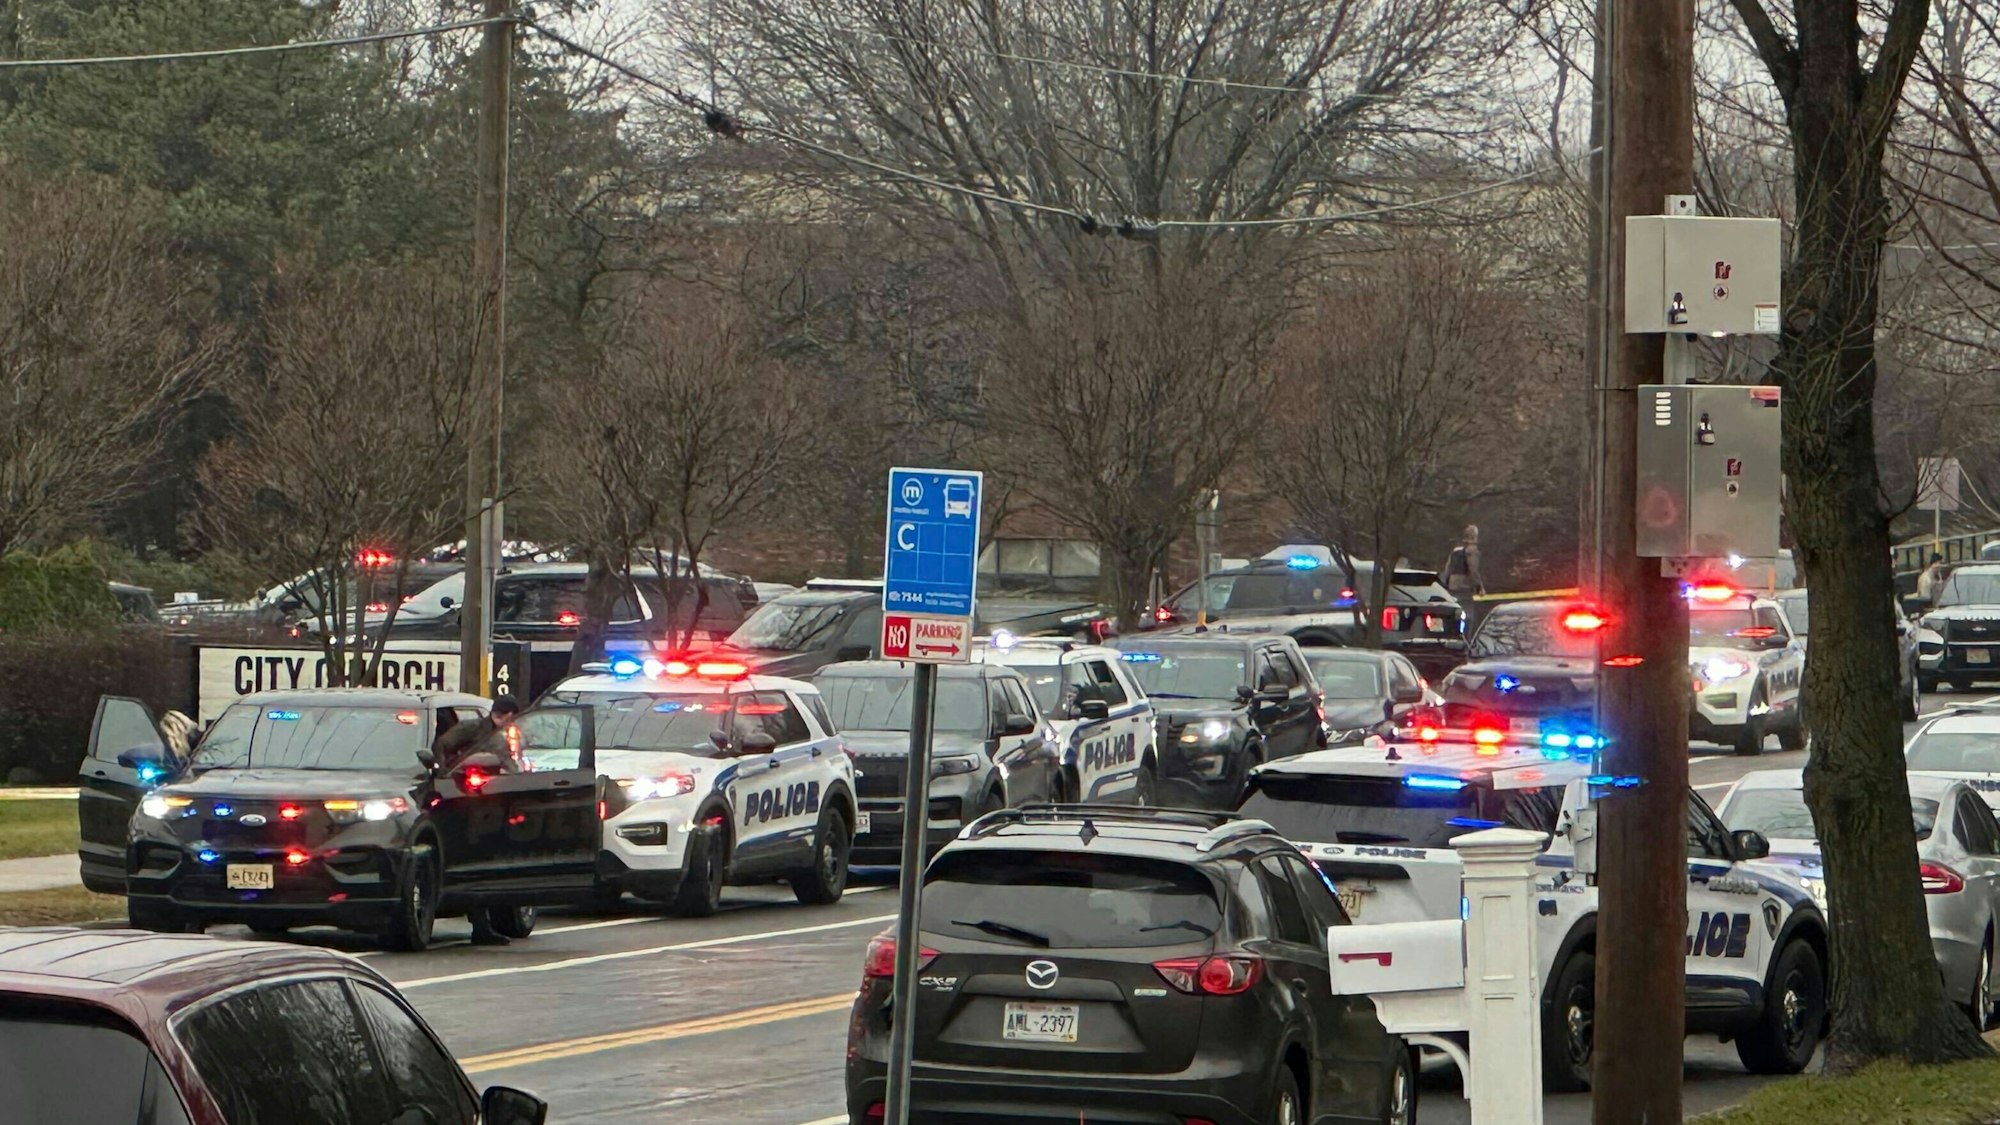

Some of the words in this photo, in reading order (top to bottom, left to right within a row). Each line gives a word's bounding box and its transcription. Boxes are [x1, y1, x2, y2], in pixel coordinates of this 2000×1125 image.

[897, 523, 915, 551] C
[887, 624, 907, 649] NO
[916, 623, 963, 641] PARKING
[234, 655, 305, 695] CITY
[1084, 732, 1136, 774] POLICE
[744, 781, 820, 826] POLICE
[1354, 846, 1427, 860] POLICE
